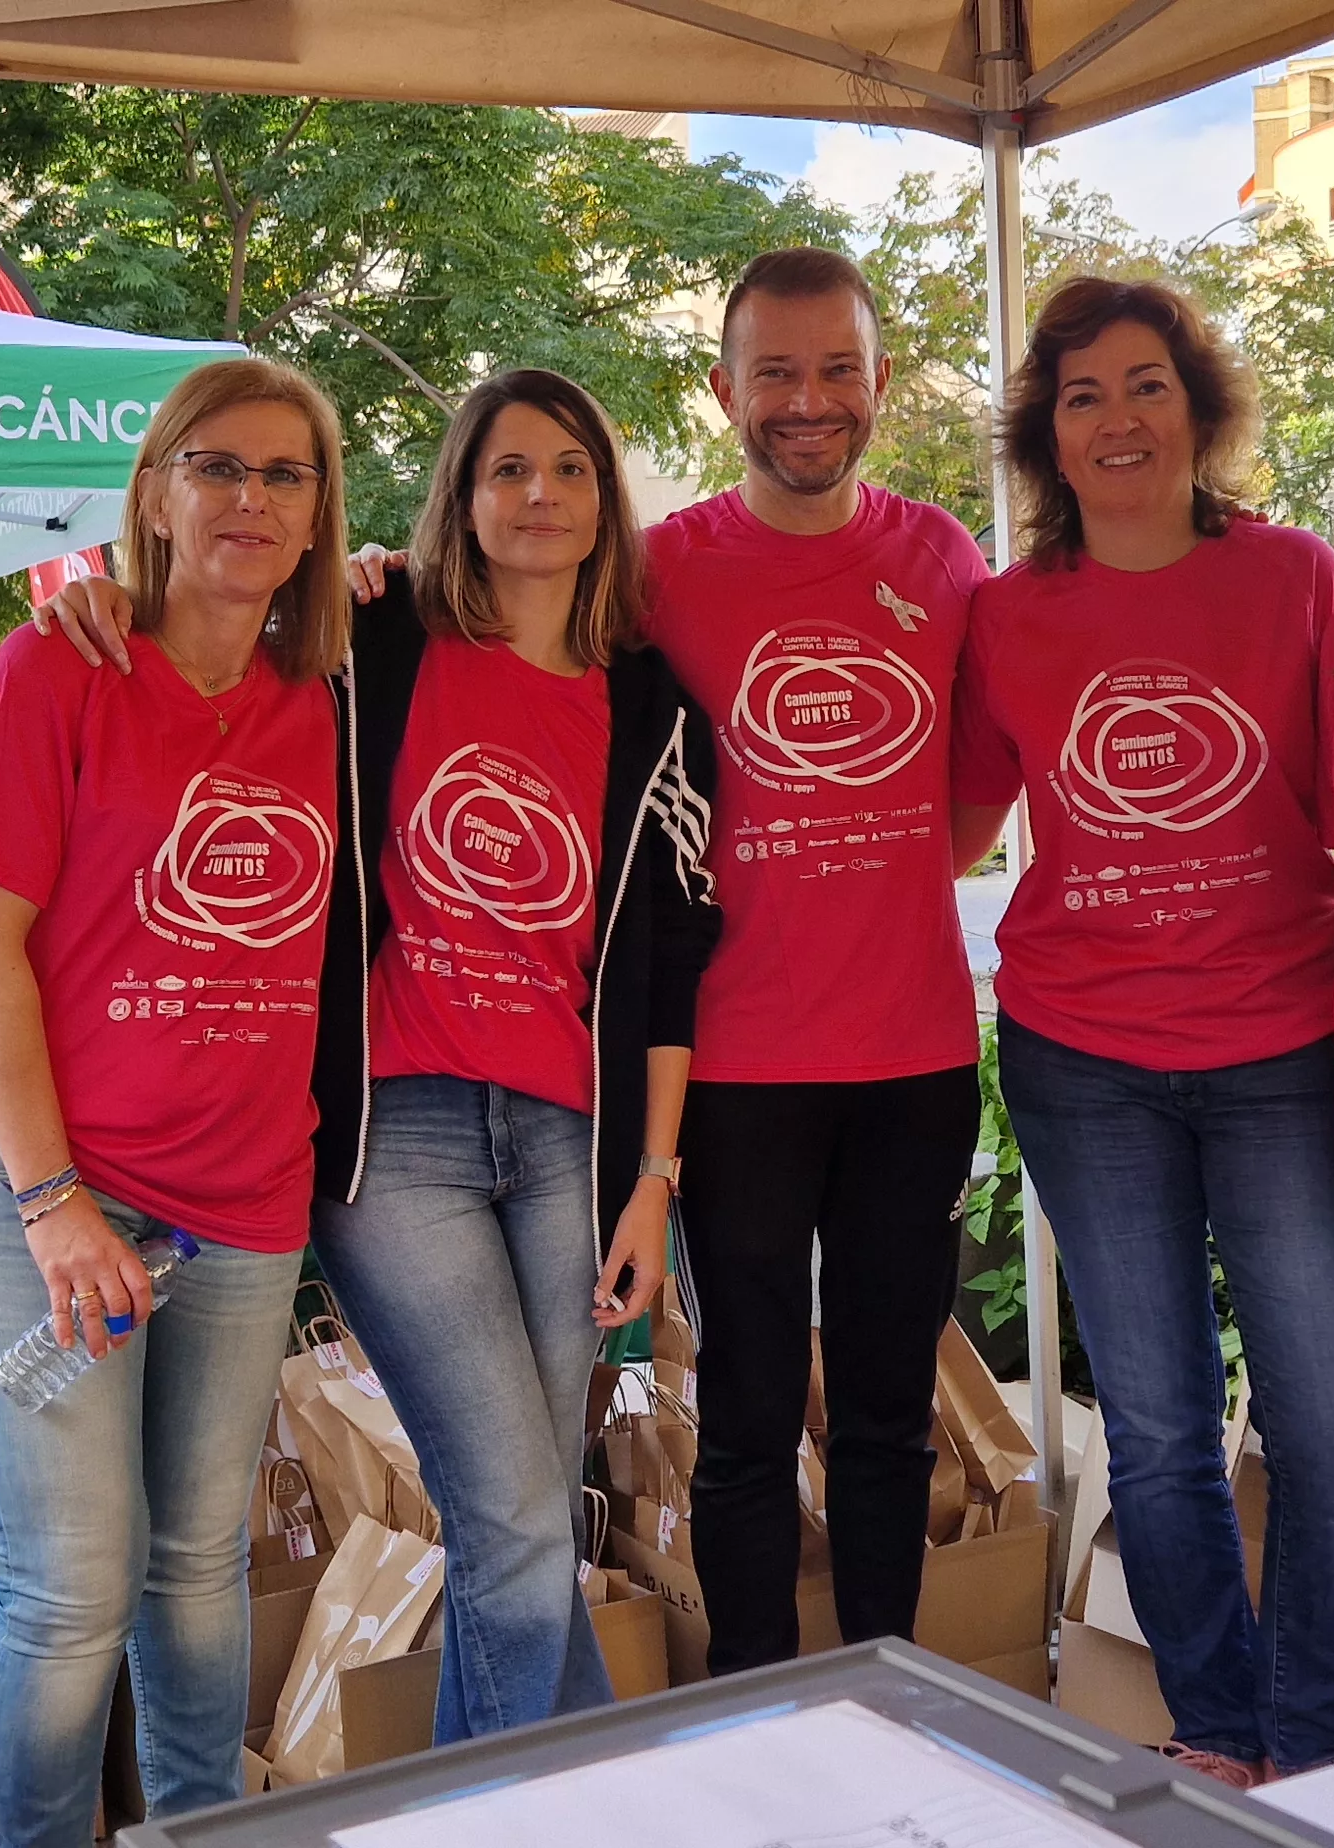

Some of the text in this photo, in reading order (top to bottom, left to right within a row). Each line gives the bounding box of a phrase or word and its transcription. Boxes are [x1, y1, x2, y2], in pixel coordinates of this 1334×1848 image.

[782, 643, 815, 652] CONTRA
[784, 689, 853, 708] Caminemos
[791, 704, 852, 726] JUNTOS
[1111, 731, 1177, 752] Caminemos
[1117, 747, 1176, 771] JUNTOS
[206, 840, 270, 857] Caminemos
[202, 857, 266, 877] JUNTOS
